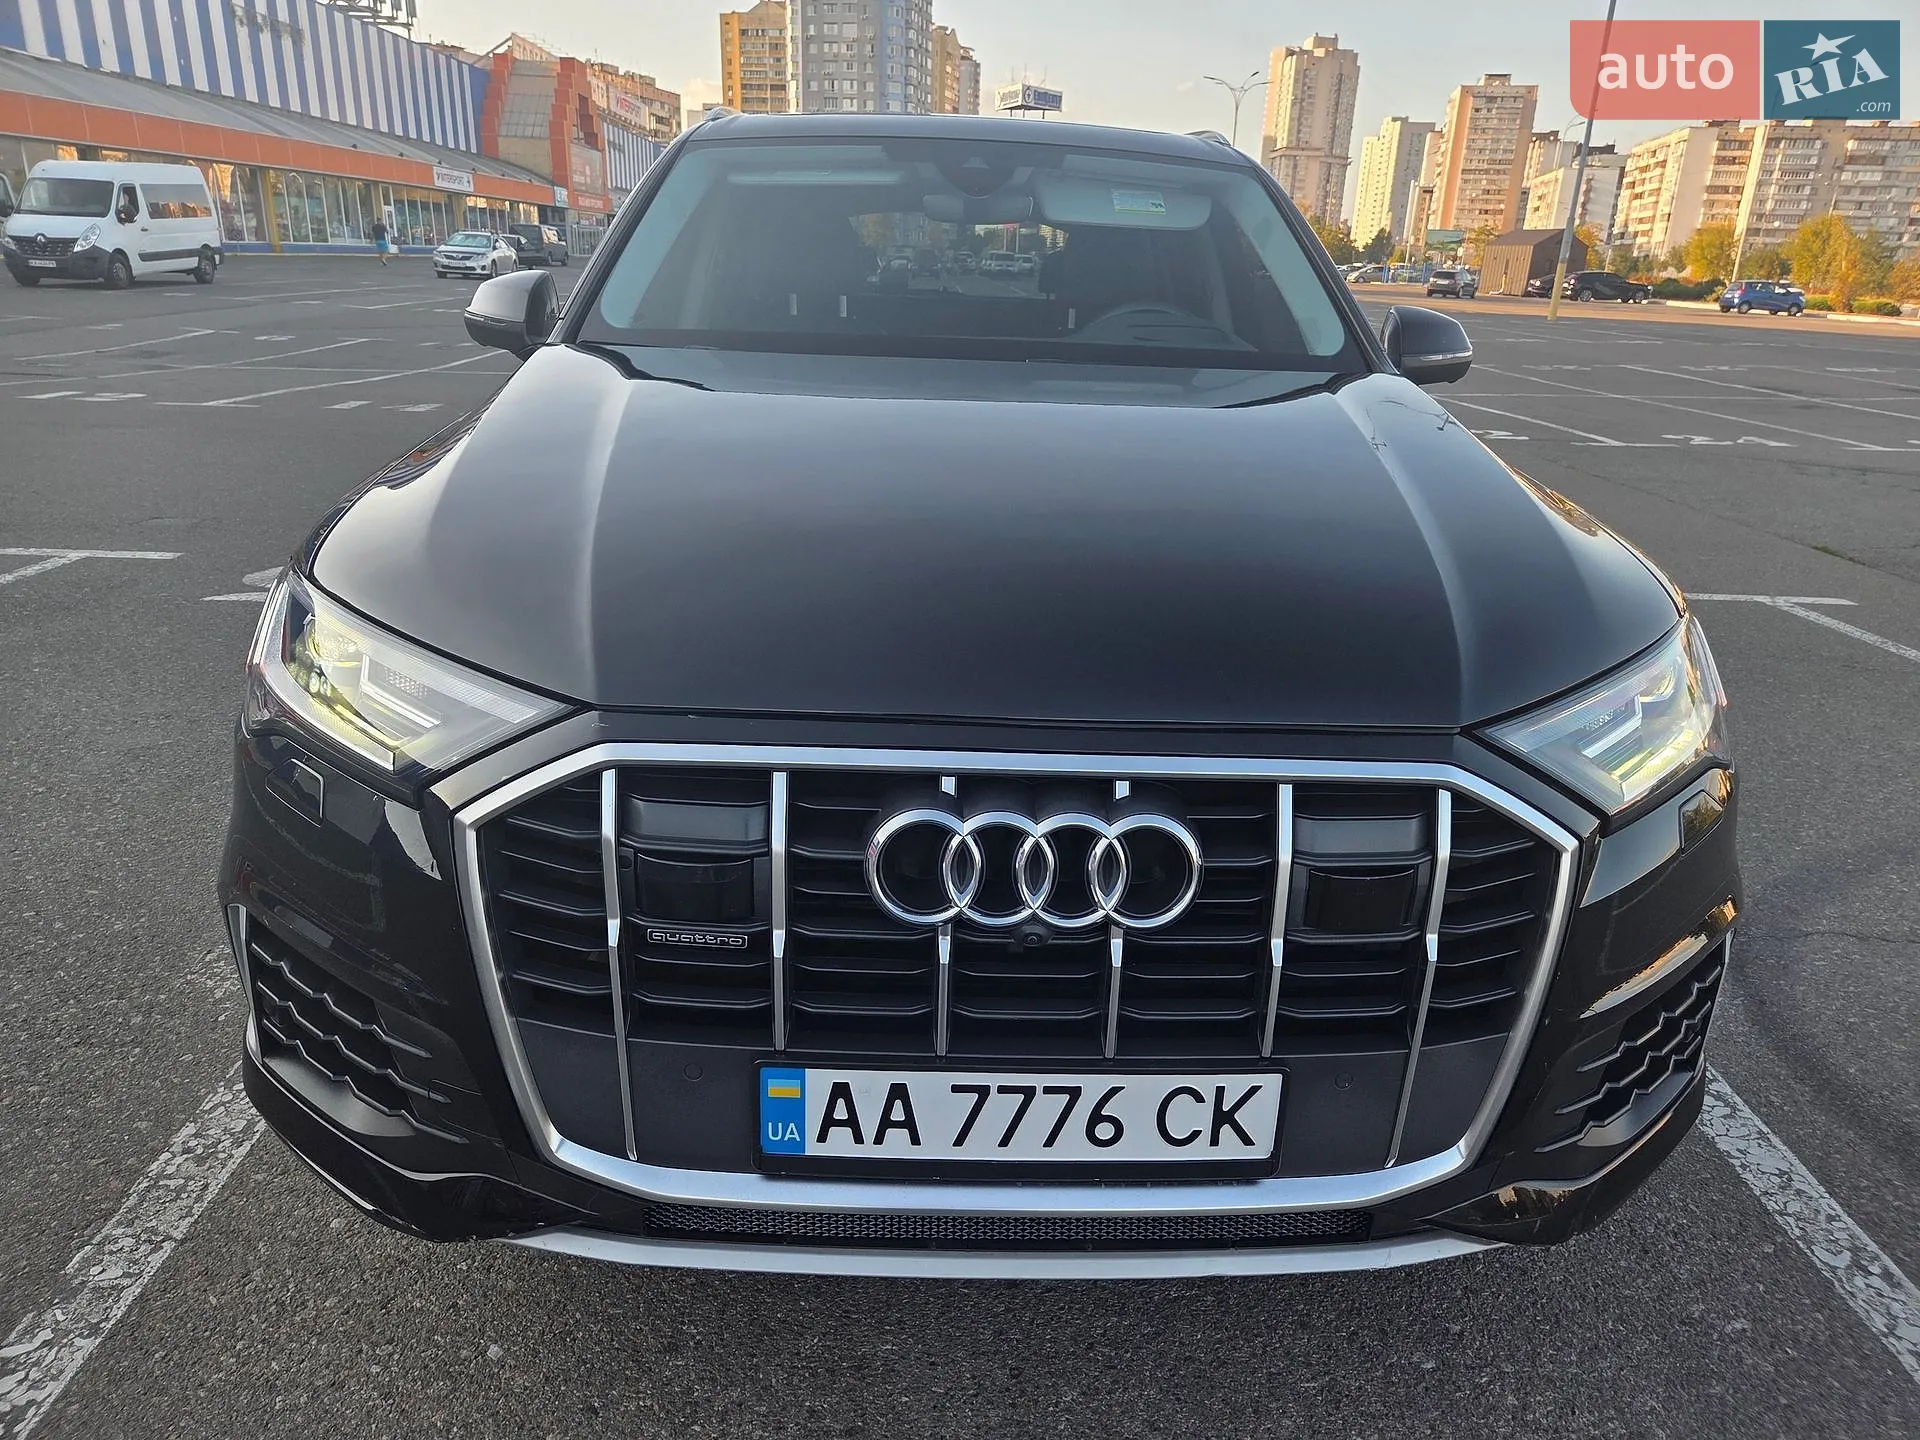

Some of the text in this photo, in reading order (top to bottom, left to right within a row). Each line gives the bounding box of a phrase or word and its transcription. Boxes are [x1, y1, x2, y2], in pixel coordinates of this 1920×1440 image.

[652, 932, 743, 945] quattro
[815, 1080, 1263, 1149] AA 7776 CK
[767, 1122, 801, 1142] UA
